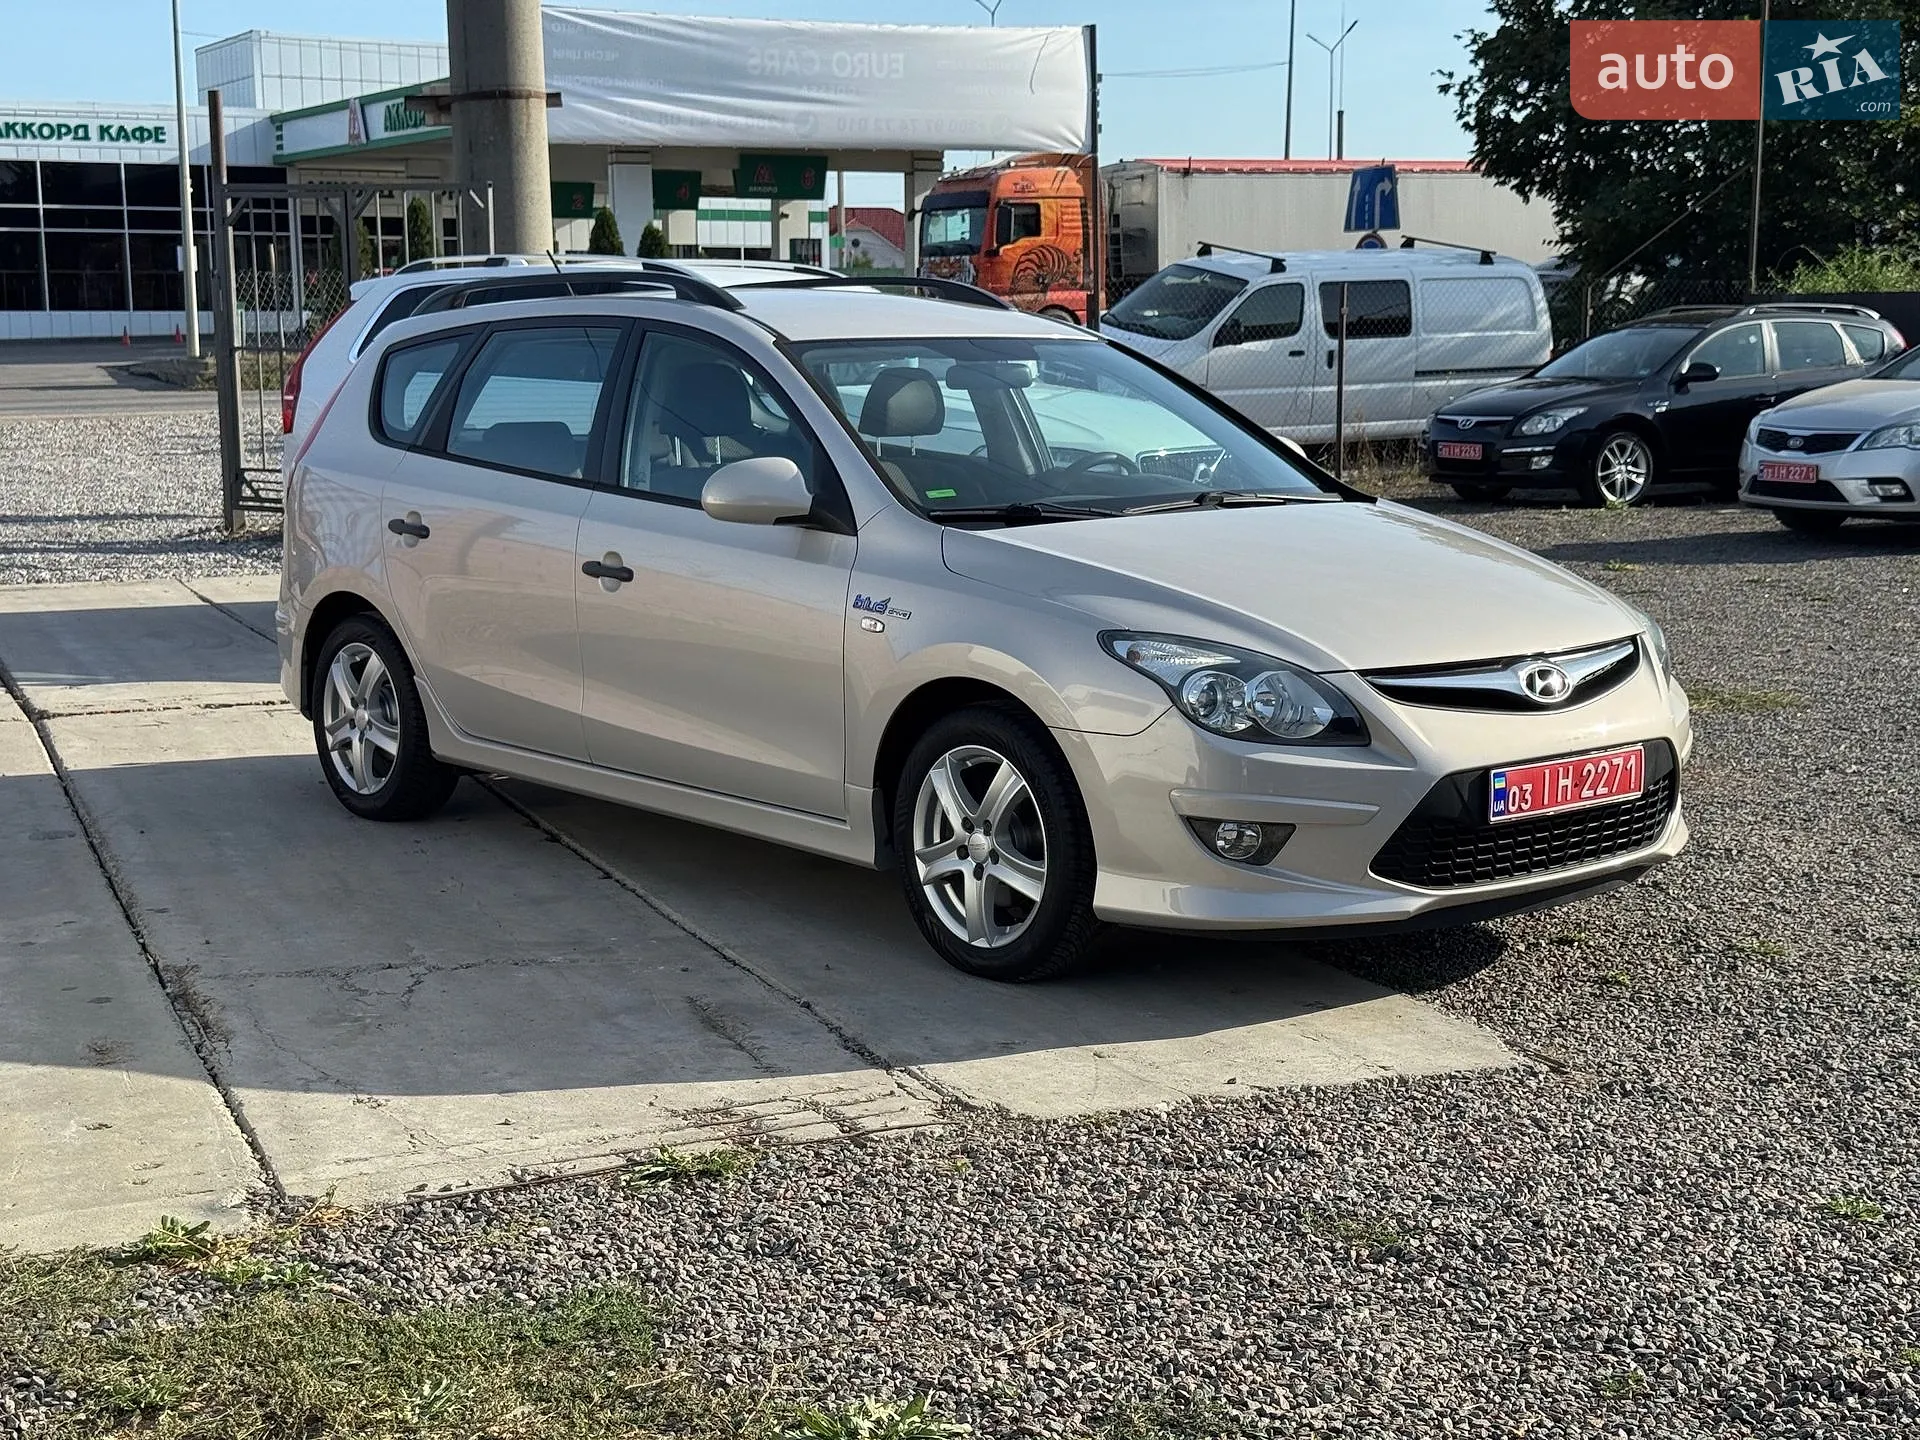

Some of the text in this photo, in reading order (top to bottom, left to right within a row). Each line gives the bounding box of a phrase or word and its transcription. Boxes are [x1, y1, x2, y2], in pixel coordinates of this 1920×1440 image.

[98, 123, 168, 144] КАФЕ
[853, 593, 889, 614] blue
[1508, 782, 1532, 813] 03
[1580, 753, 1637, 799] 2271
[1493, 799, 1505, 811] UA
